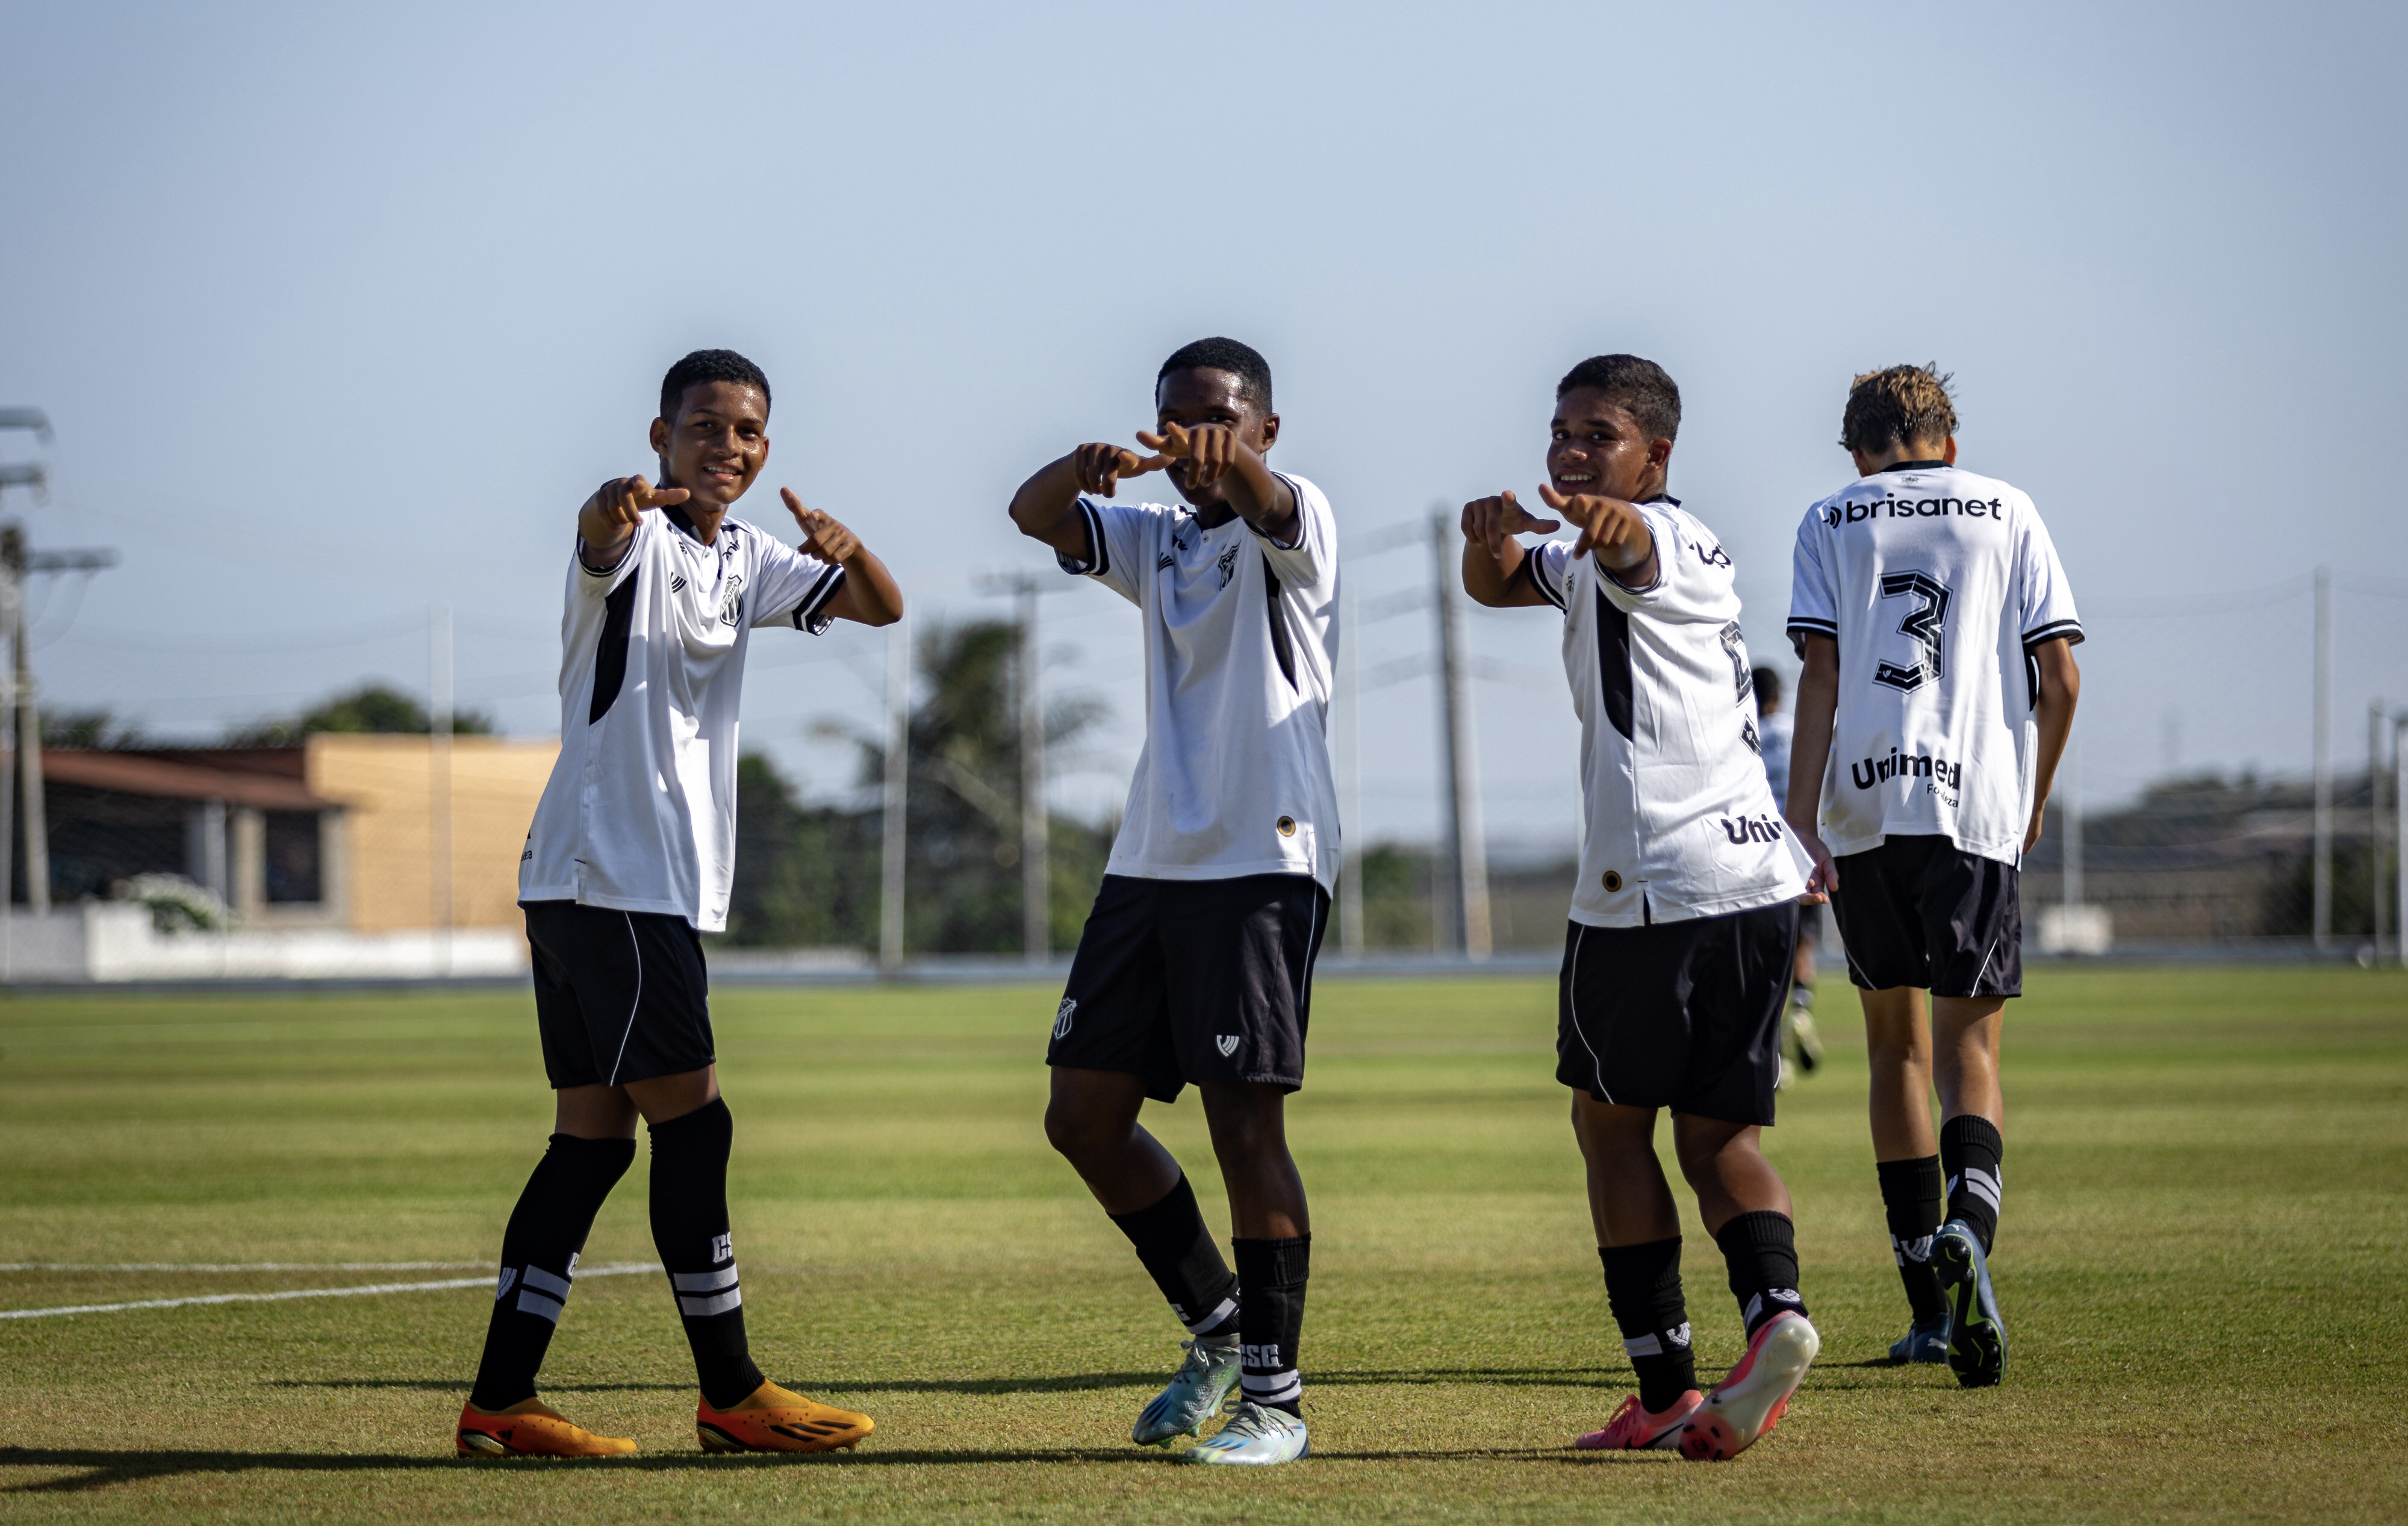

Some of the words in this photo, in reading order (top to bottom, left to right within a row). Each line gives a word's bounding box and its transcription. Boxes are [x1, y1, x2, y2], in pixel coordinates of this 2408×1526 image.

[1847, 493, 2002, 523] brisanet
[1872, 569, 1953, 695] 3
[1852, 746, 1961, 791] Unimed
[1240, 1344, 1279, 1368] CSC
